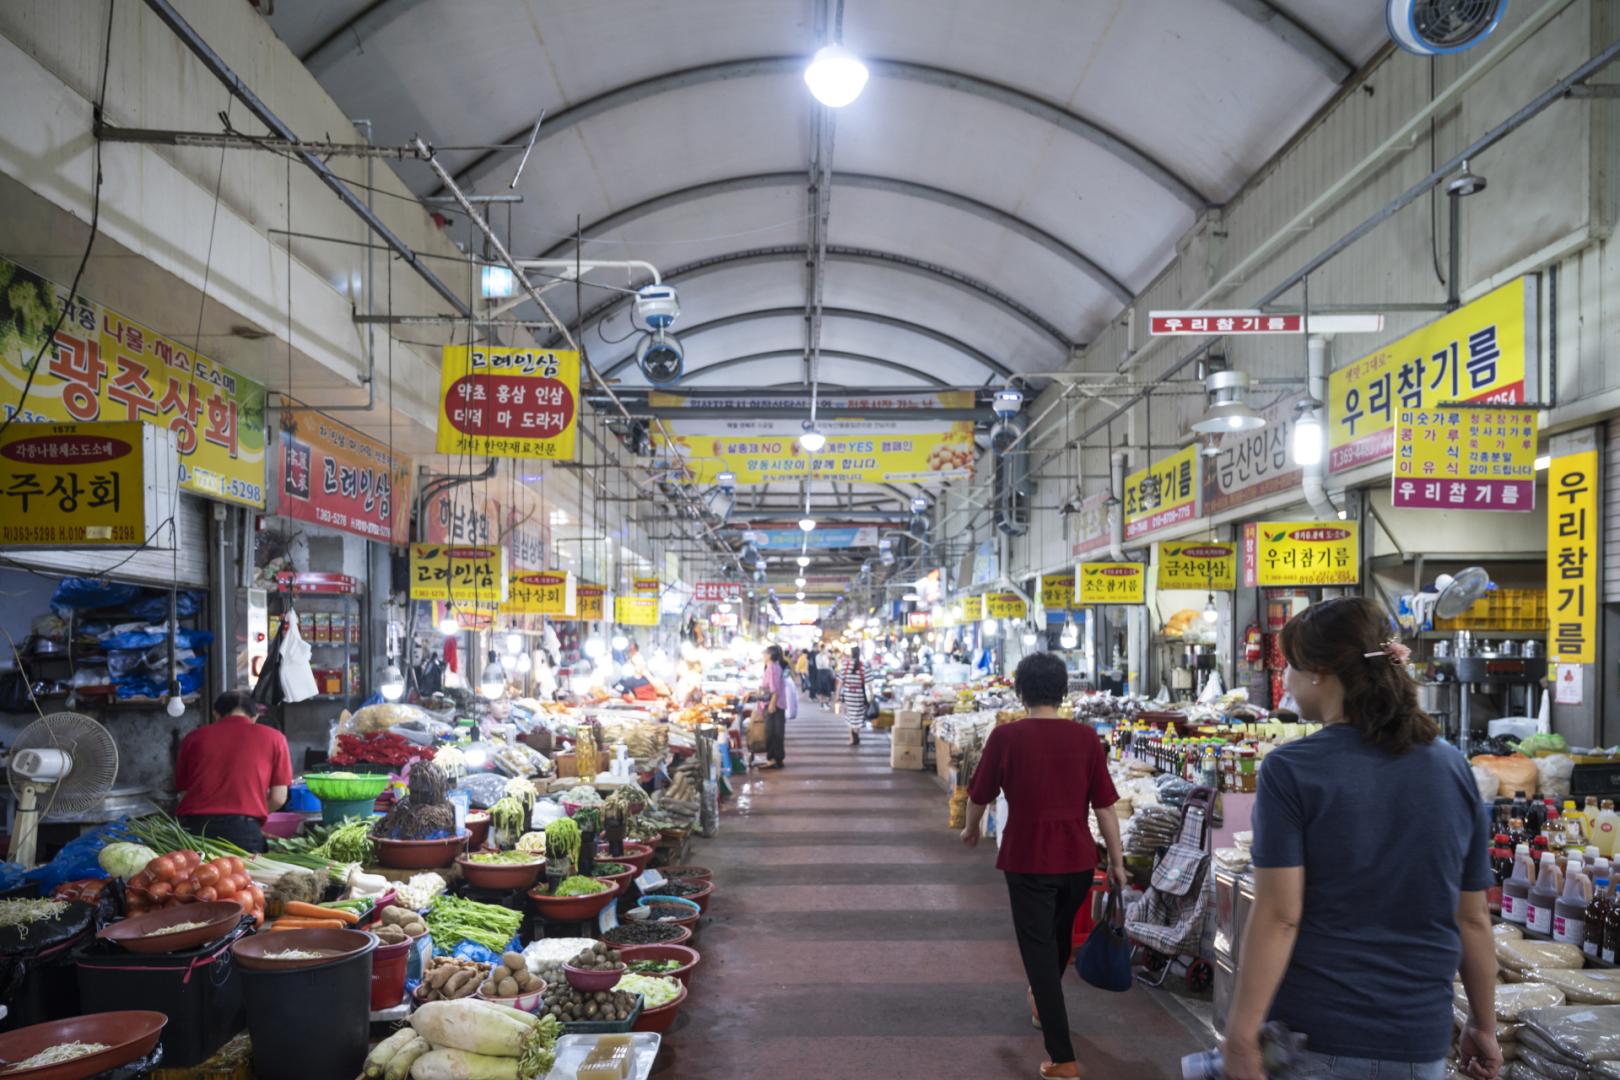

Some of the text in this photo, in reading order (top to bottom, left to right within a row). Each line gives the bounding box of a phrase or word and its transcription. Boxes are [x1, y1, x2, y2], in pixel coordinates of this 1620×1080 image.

[1165, 317, 1286, 331] 우리참기름
[471, 351, 560, 378] 고려인삼
[194, 362, 236, 395] 도소매
[1341, 325, 1501, 436] 우리참기름
[48, 330, 238, 460] 광주상회
[457, 383, 564, 406] 약초 홍삼 인삼
[454, 407, 564, 430] 더덕 마 도라지
[1401, 412, 1460, 426] 미숫가루
[1401, 428, 1459, 442] 콩가루
[1220, 420, 1289, 489] 금산인삼
[1400, 444, 1459, 459] 선식
[1400, 461, 1459, 475] 이유식
[1492, 464, 1532, 475] 드립니다
[0, 471, 120, 513] 주상회
[323, 455, 391, 521] 고려인삼
[1398, 481, 1520, 505] 우리참기름
[1165, 560, 1227, 577] 금산인삼
[1264, 547, 1351, 569] 우리참기름
[1553, 470, 1589, 655] 우리참기름
[417, 563, 494, 587] 고려인삼
